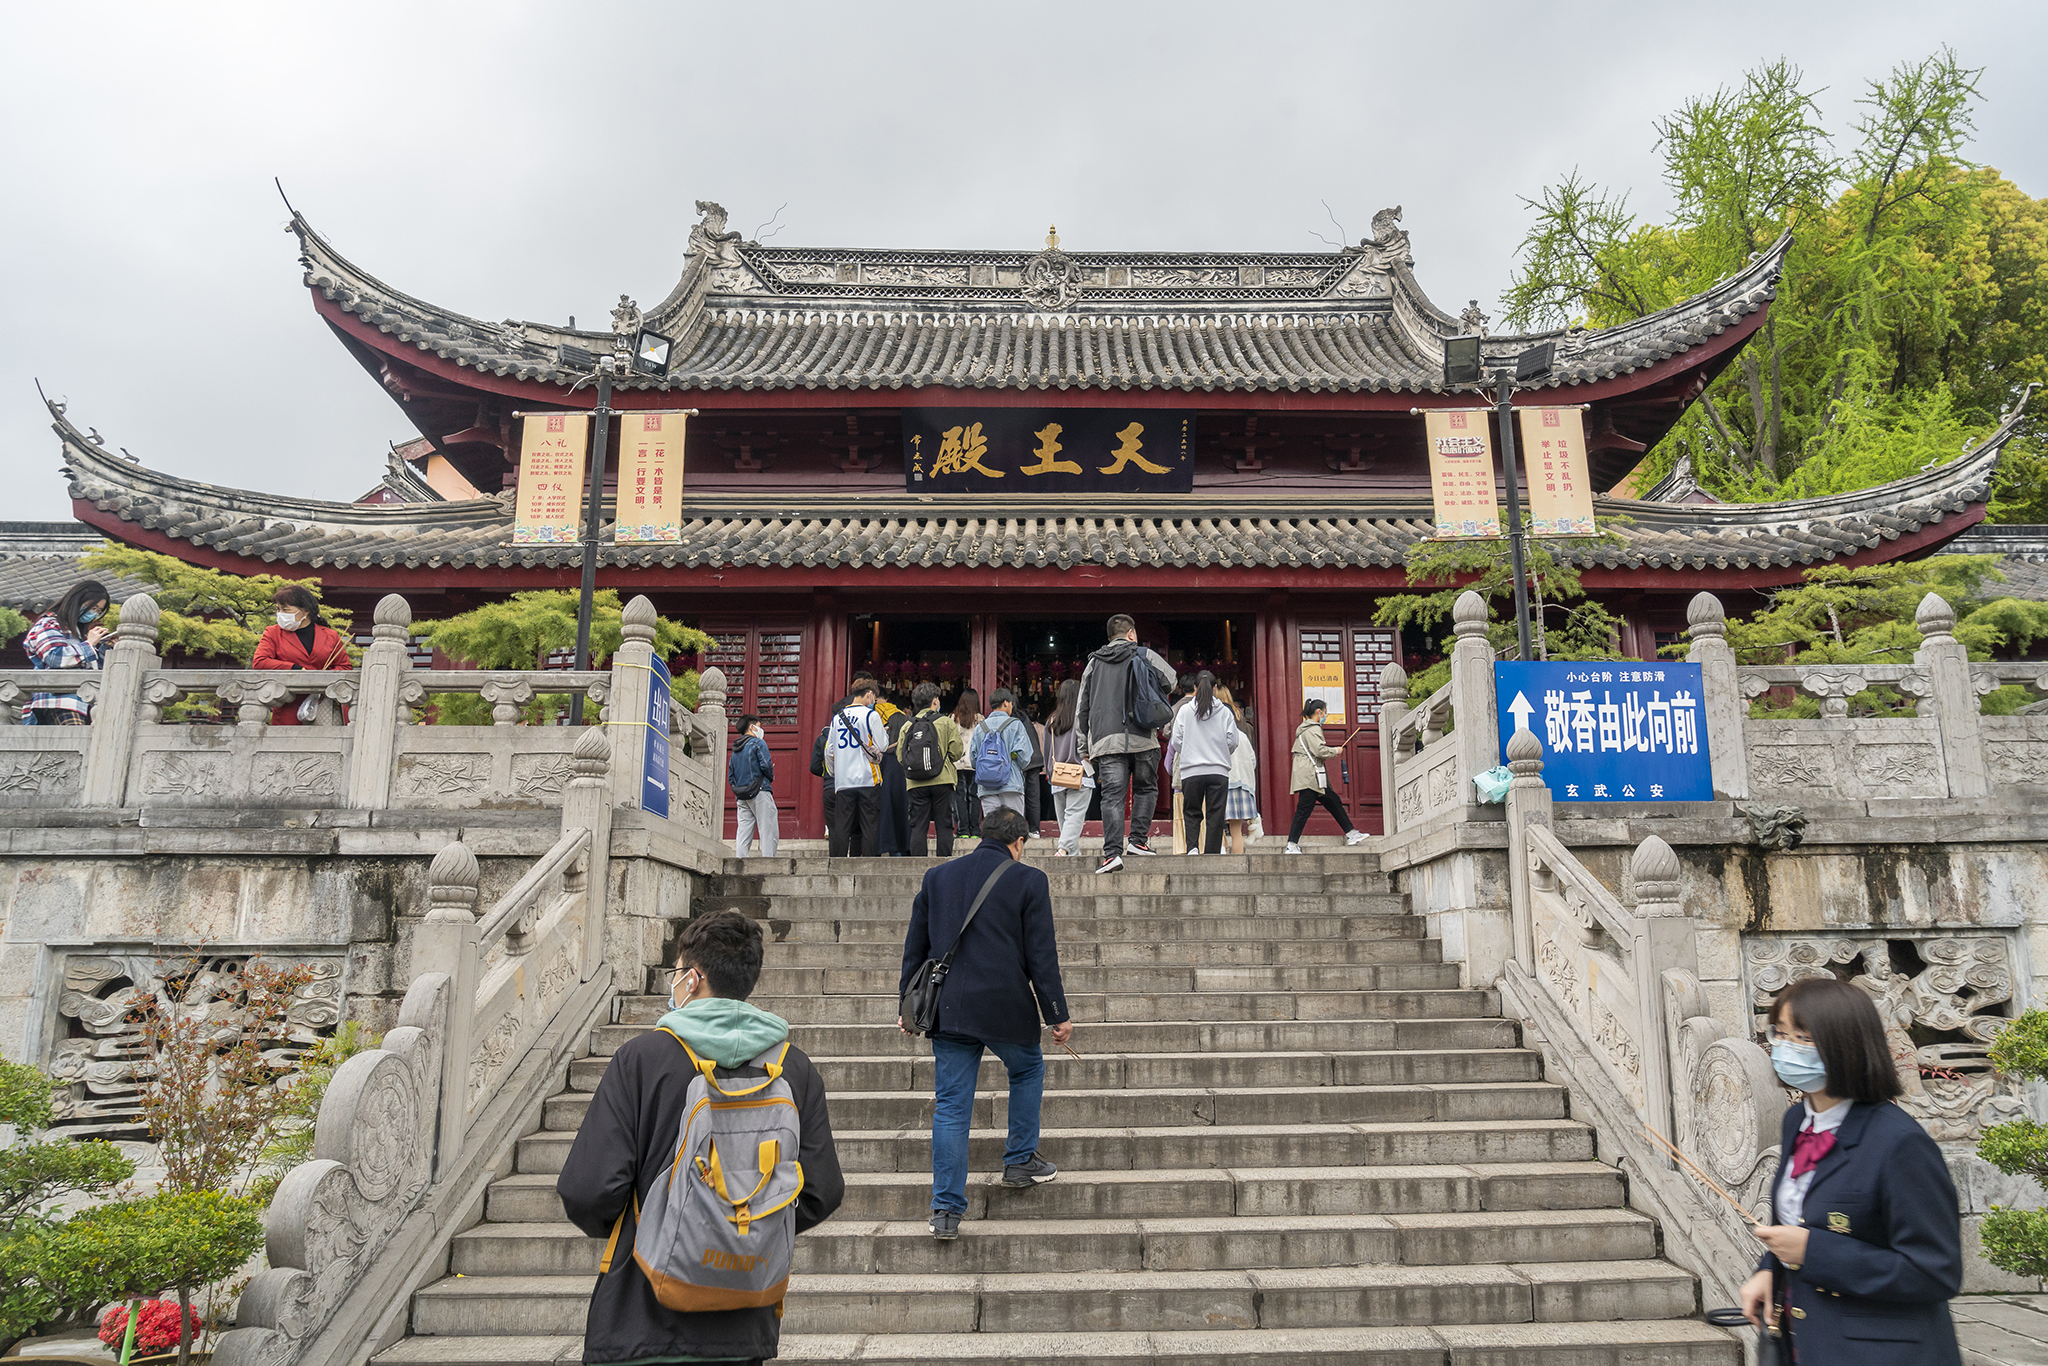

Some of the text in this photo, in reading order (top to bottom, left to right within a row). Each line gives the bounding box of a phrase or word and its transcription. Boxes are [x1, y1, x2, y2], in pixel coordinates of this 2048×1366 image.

[540, 438, 568, 448] 八礼
[929, 421, 1175, 478] 天王殿
[1435, 436, 1486, 447] 社会主义
[537, 482, 563, 492] 四仪
[635, 442, 648, 510] 一言一行要文明。
[653, 441, 666, 510] 一花一木皆是景，
[1566, 670, 1666, 683] 小心台阶 注意防滑
[652, 687, 669, 730] 出口
[1544, 689, 1698, 755] 敬香由此向前
[837, 727, 861, 749] 30
[1565, 783, 1664, 798] 玄武公安
[701, 1248, 757, 1273] PUMA
